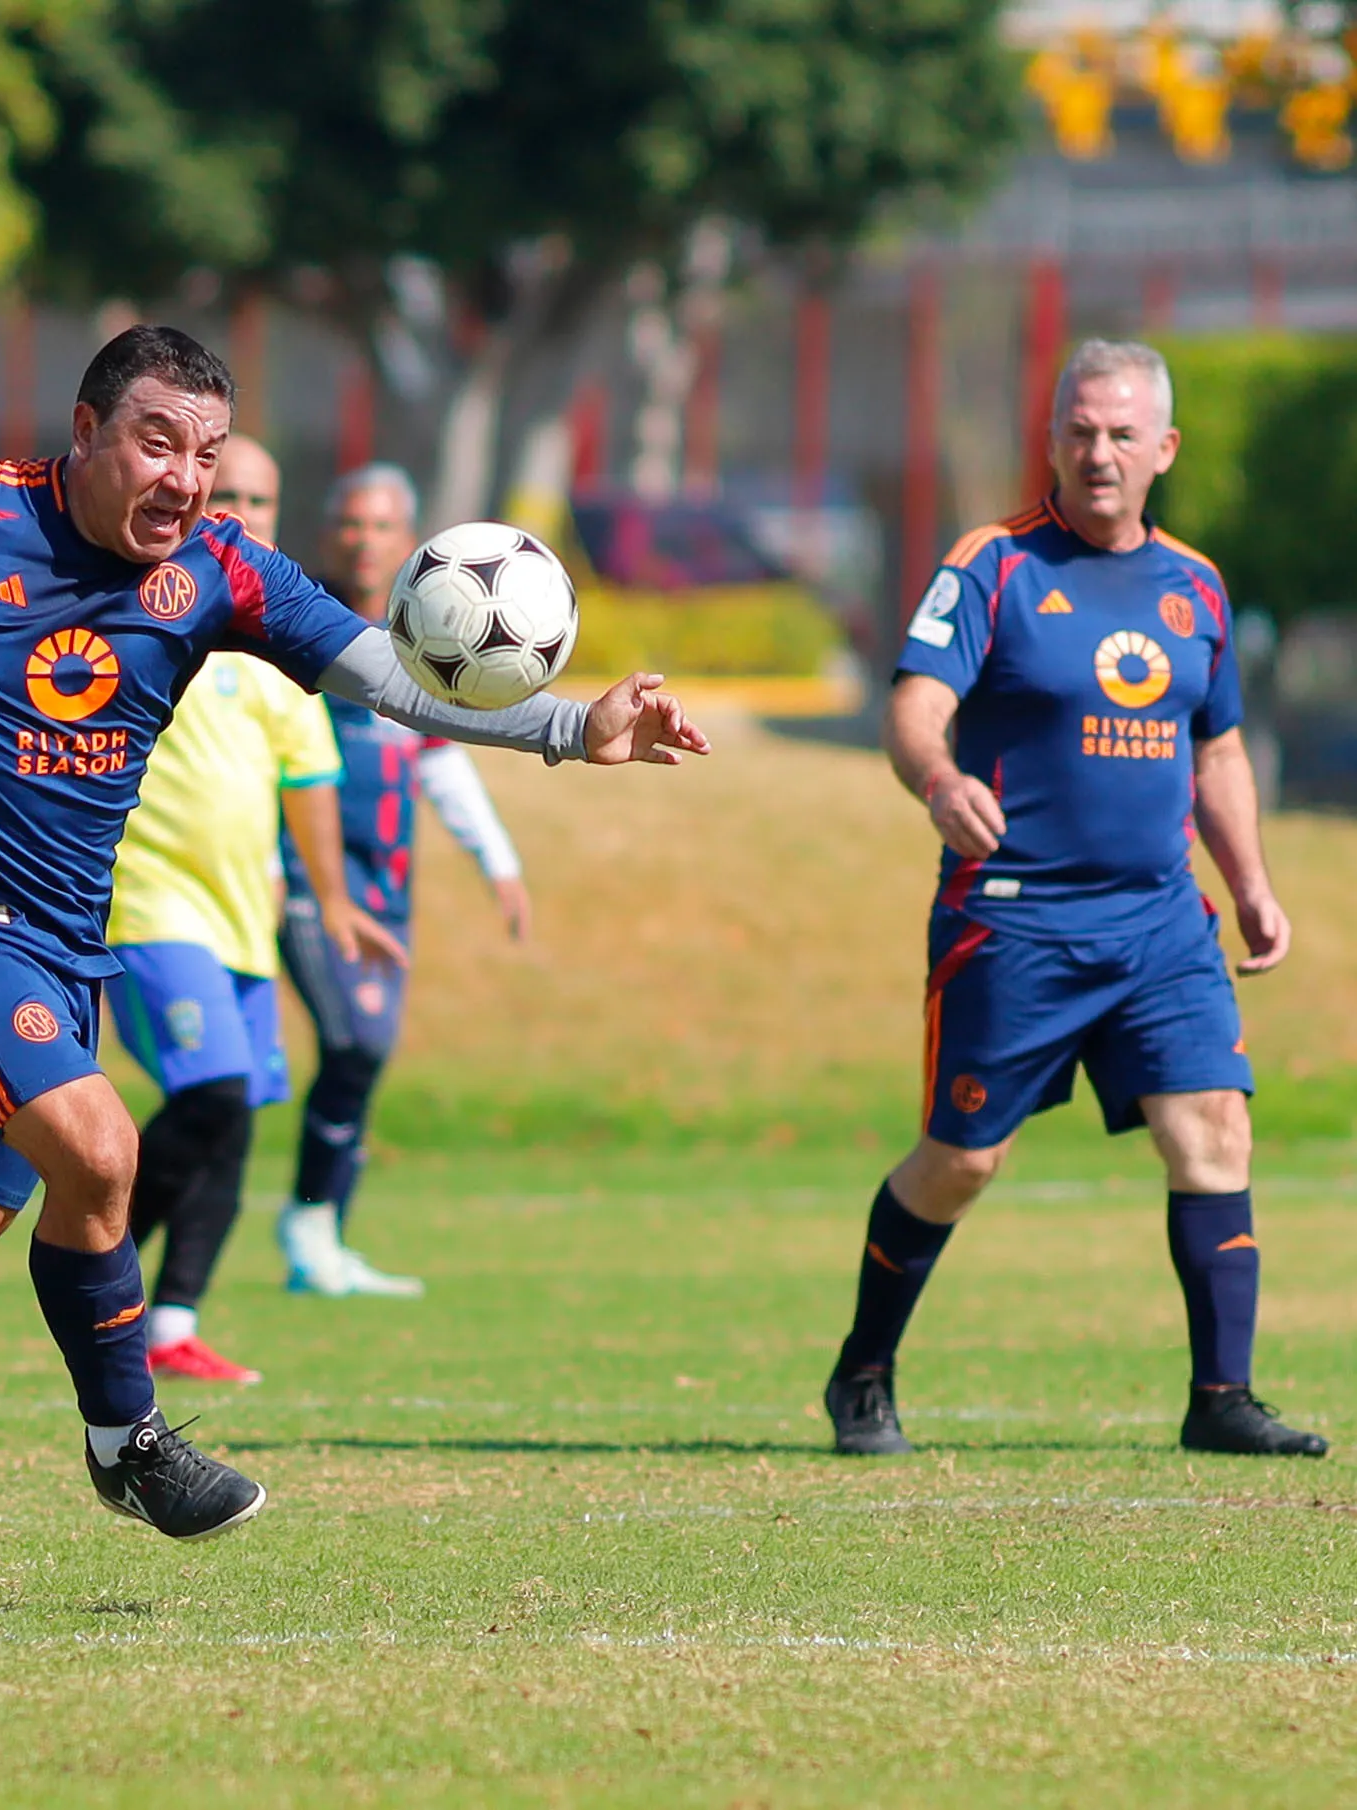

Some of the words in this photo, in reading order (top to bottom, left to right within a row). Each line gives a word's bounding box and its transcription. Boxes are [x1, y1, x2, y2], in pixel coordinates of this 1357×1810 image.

[143, 567, 191, 613] ASR
[1082, 715, 1178, 738] RIYADH
[17, 730, 127, 753] RIYADH
[1082, 736, 1176, 759] SEASON
[17, 751, 125, 775] SEASON
[18, 1007, 55, 1036] ASR
